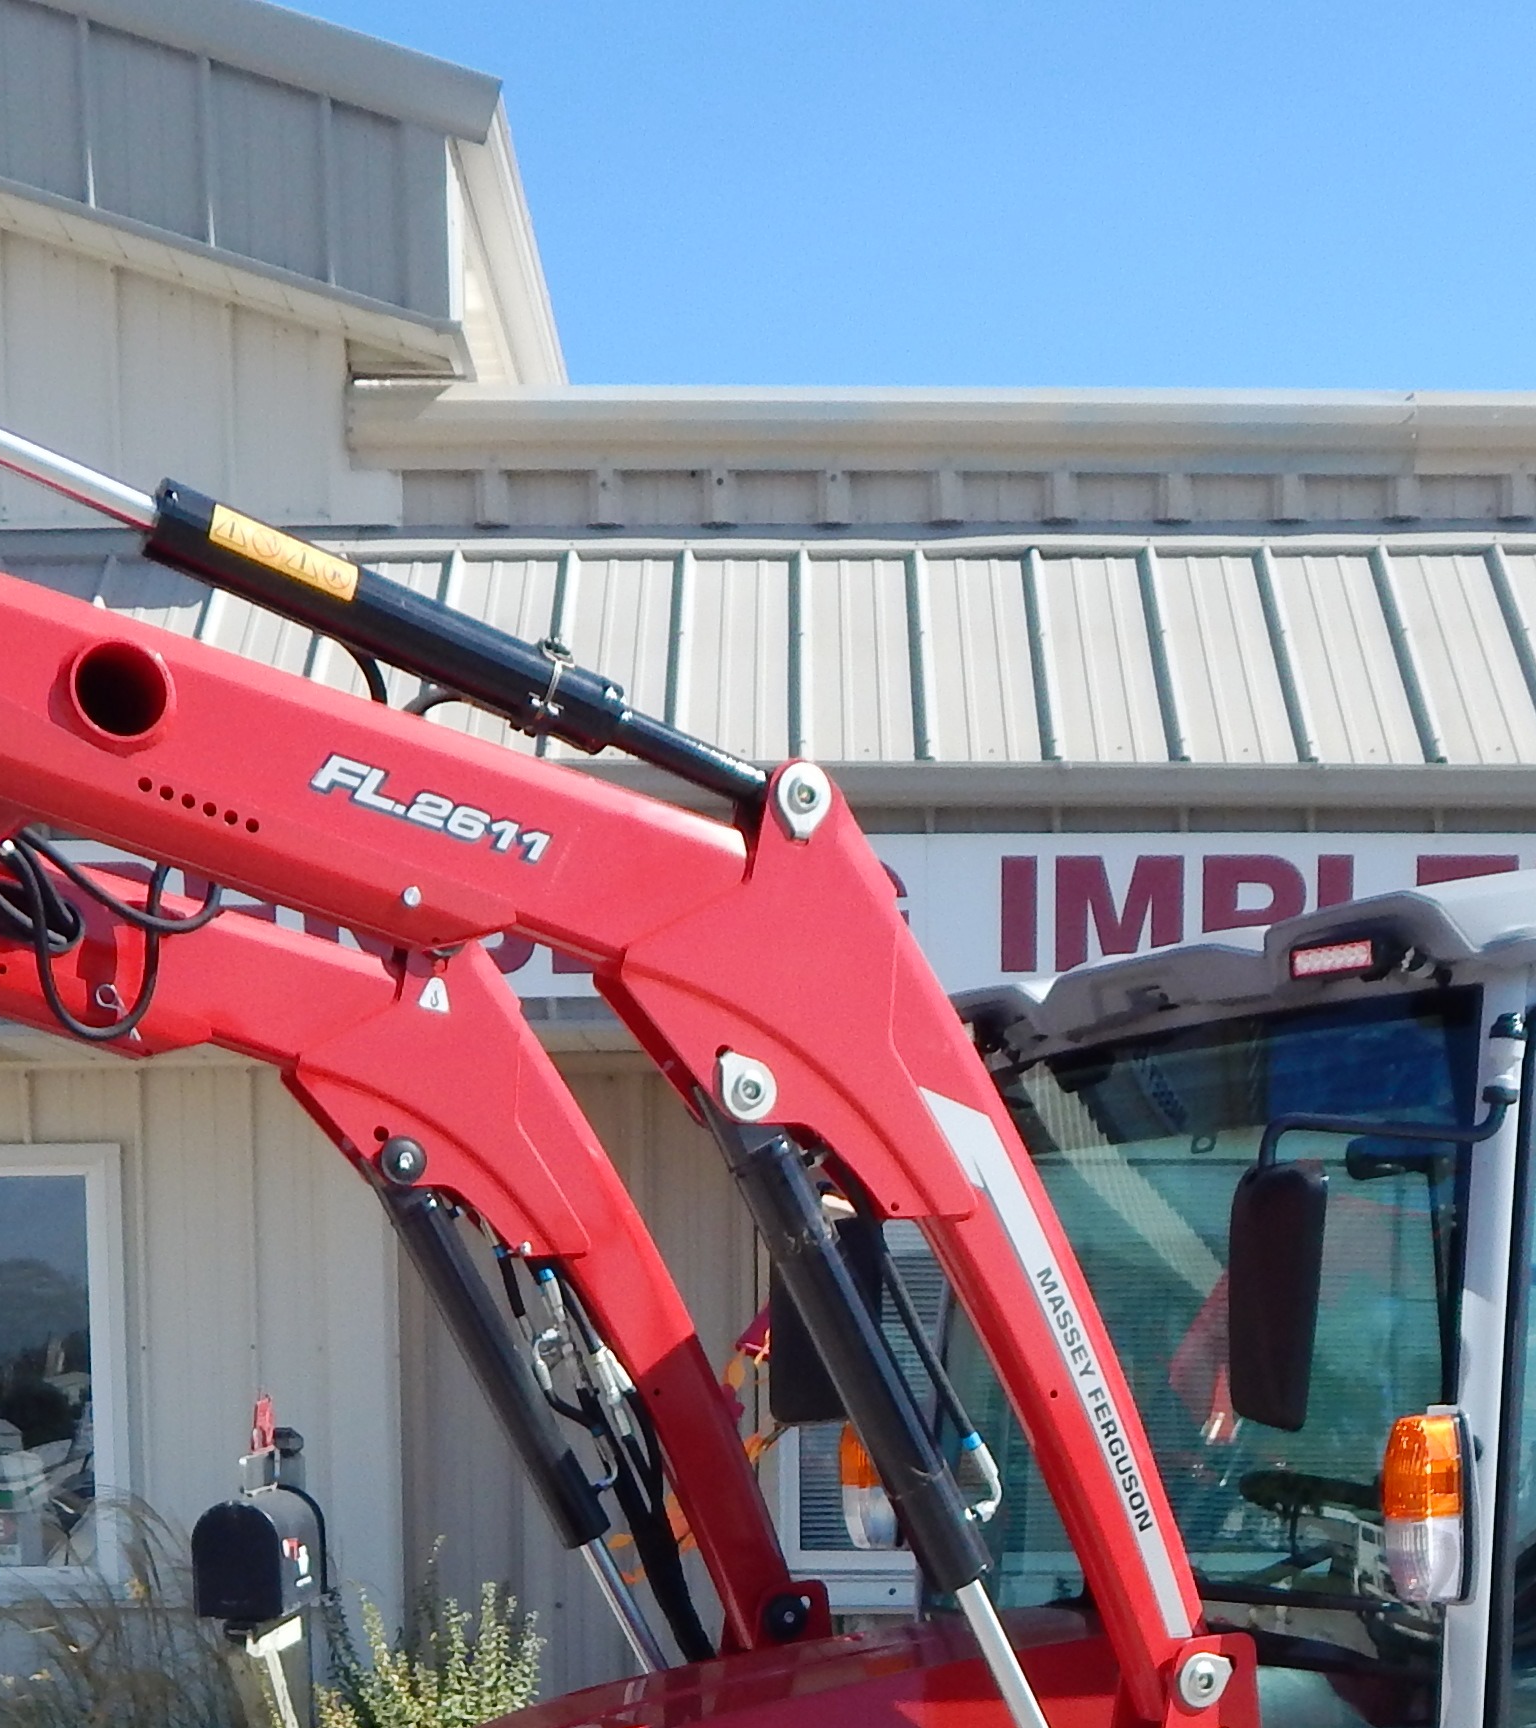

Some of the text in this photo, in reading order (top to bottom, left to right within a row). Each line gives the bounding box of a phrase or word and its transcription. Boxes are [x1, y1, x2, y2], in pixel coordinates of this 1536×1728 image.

[310, 753, 553, 863] FL.2611
[1036, 1266, 1153, 1533] MASSEY FERGUSON
